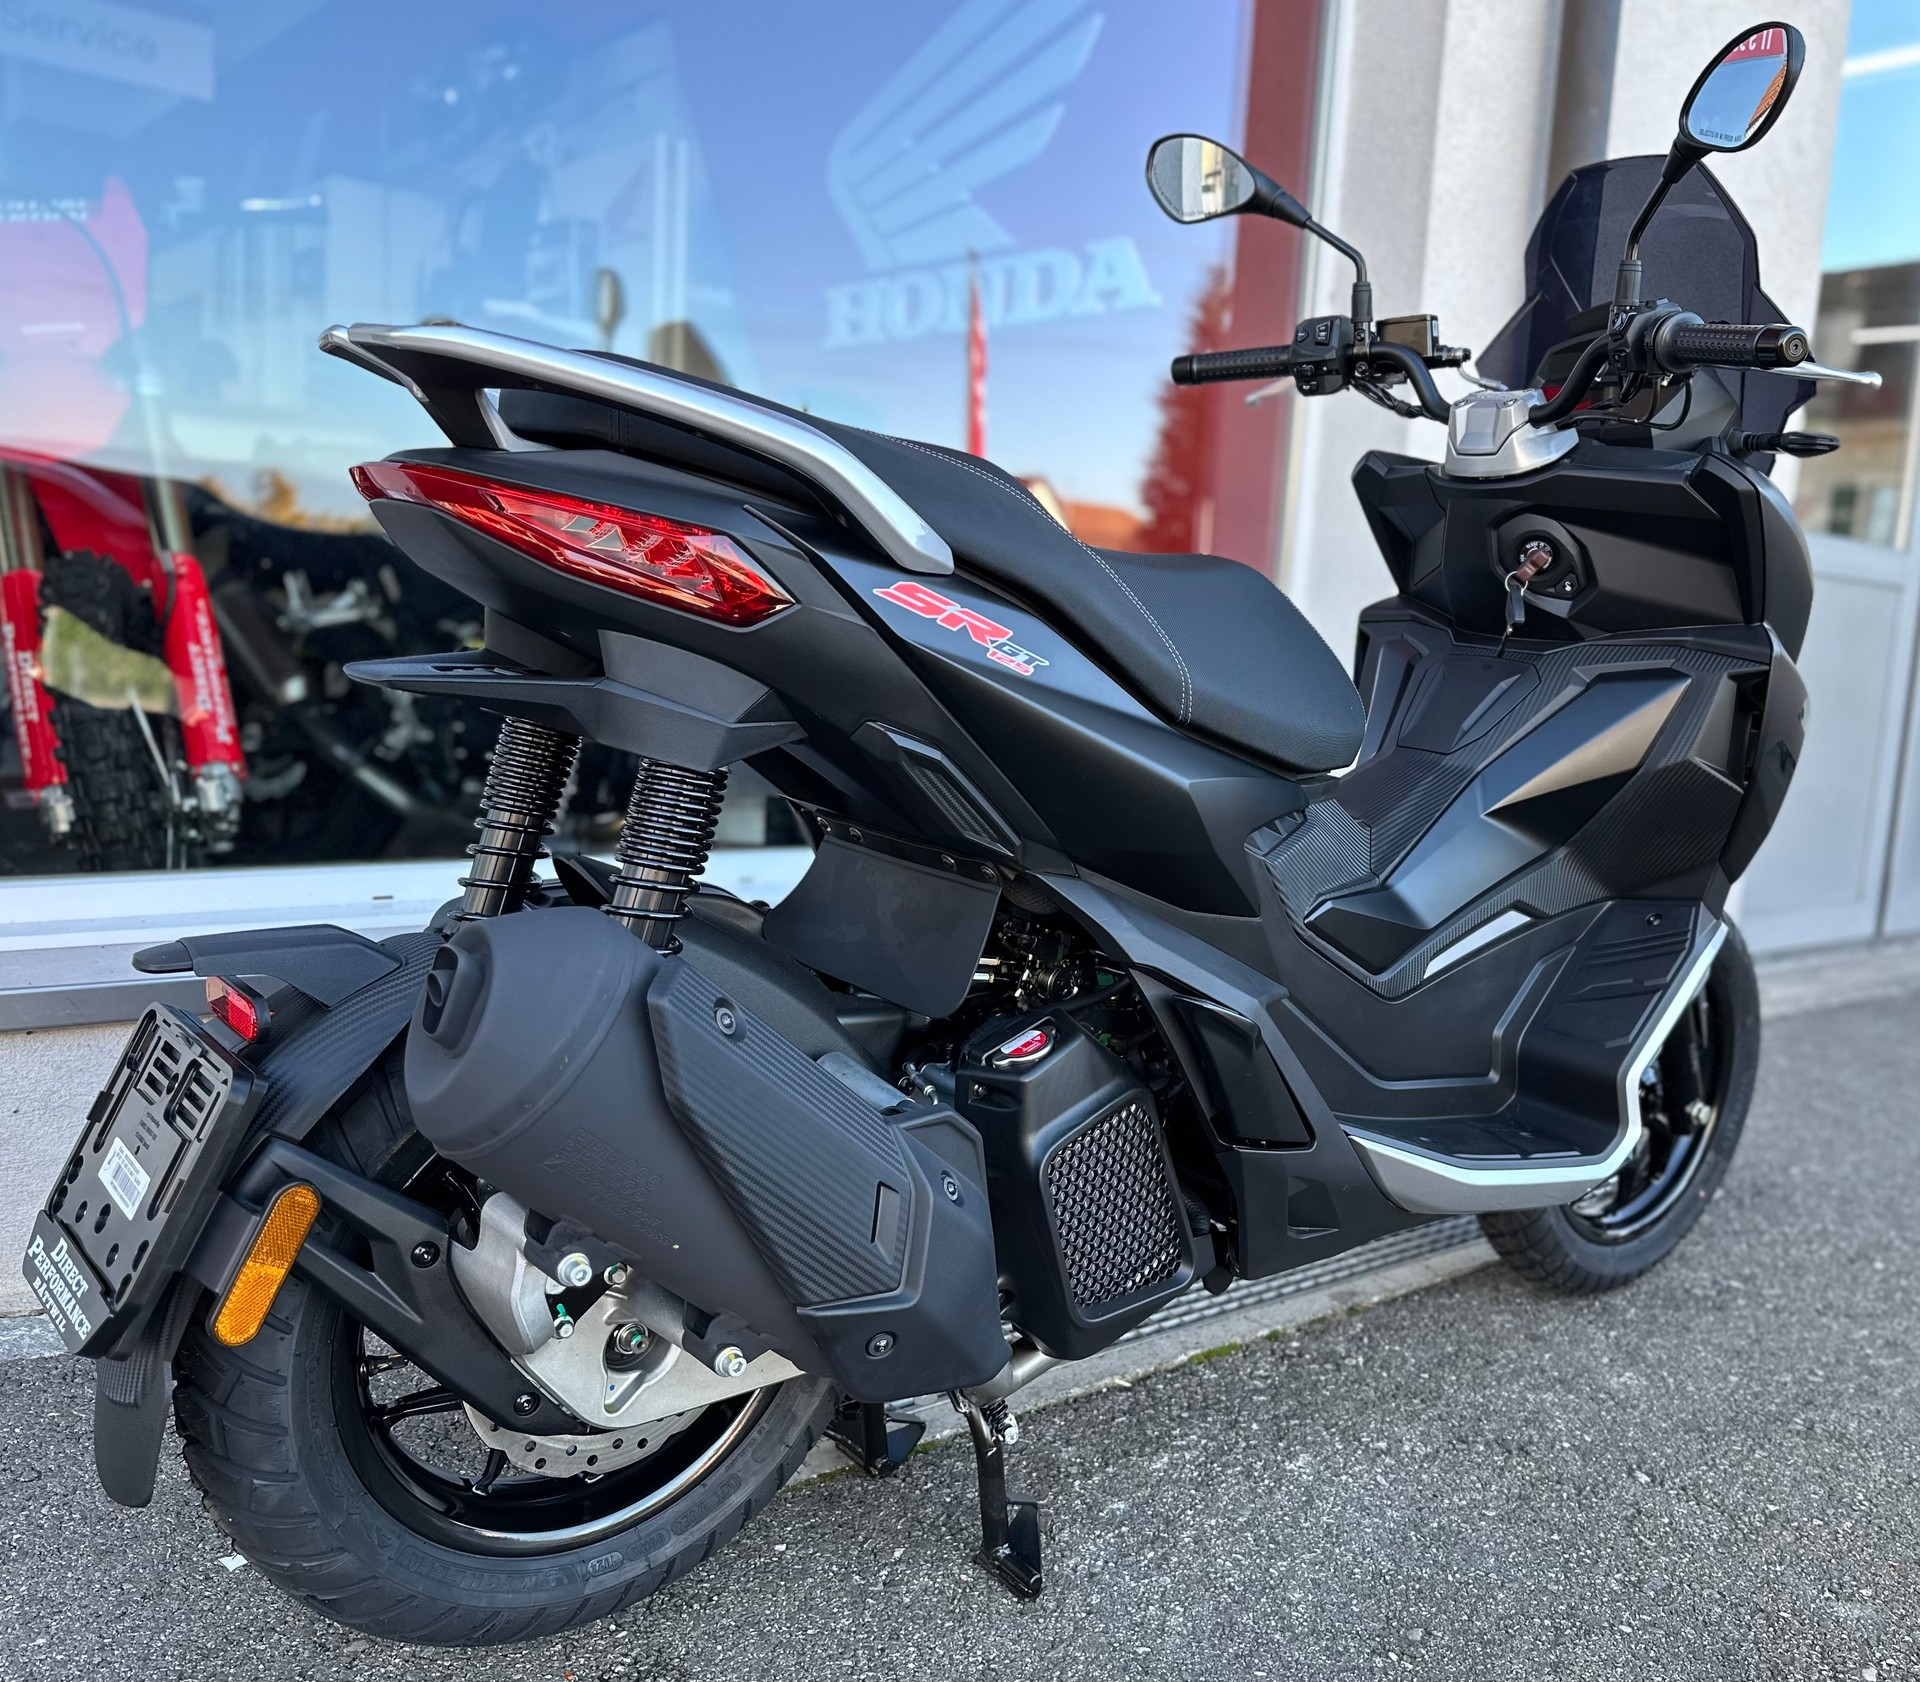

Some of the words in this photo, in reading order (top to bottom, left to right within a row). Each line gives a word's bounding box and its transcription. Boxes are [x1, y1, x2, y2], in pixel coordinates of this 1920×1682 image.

[822, 236, 1162, 349] HONDA
[873, 582, 1013, 647] SR
[991, 640, 1049, 667] GT
[987, 650, 1034, 676] 125
[27, 1234, 92, 1340] PERFORMANCE
[50, 1237, 89, 1298] DIRECT
